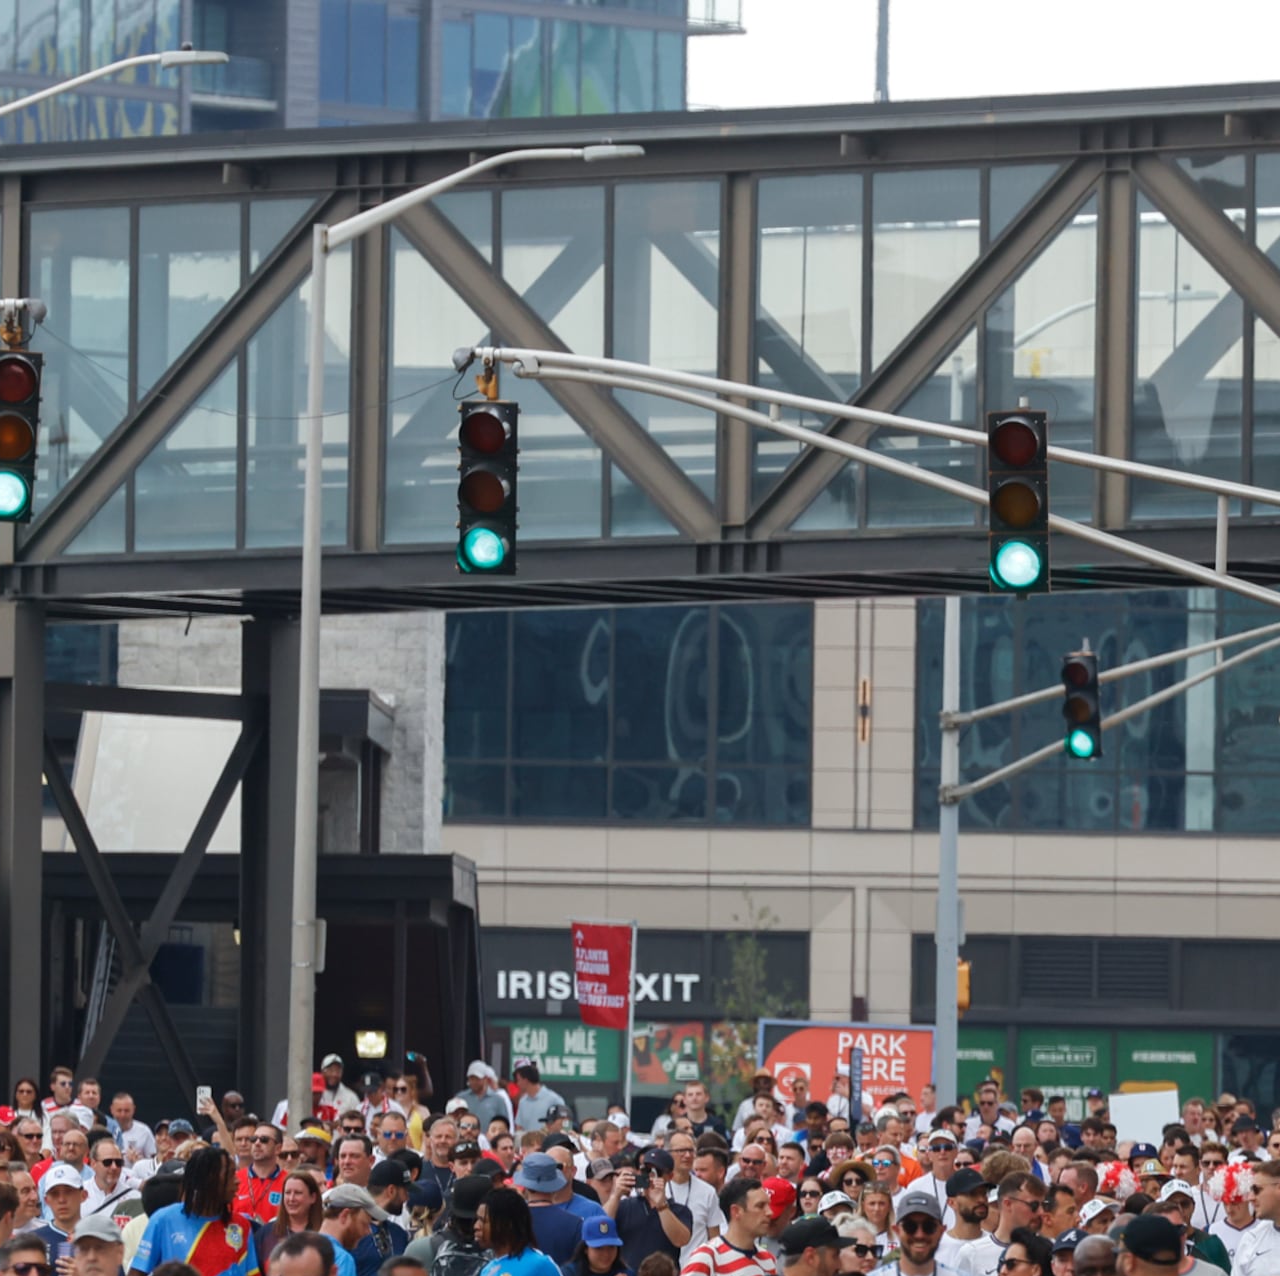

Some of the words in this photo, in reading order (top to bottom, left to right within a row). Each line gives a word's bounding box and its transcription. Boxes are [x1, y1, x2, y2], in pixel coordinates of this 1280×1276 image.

[497, 970, 578, 1000] IRIS
[629, 973, 700, 1002] XIT
[838, 1032, 907, 1057] PARK
